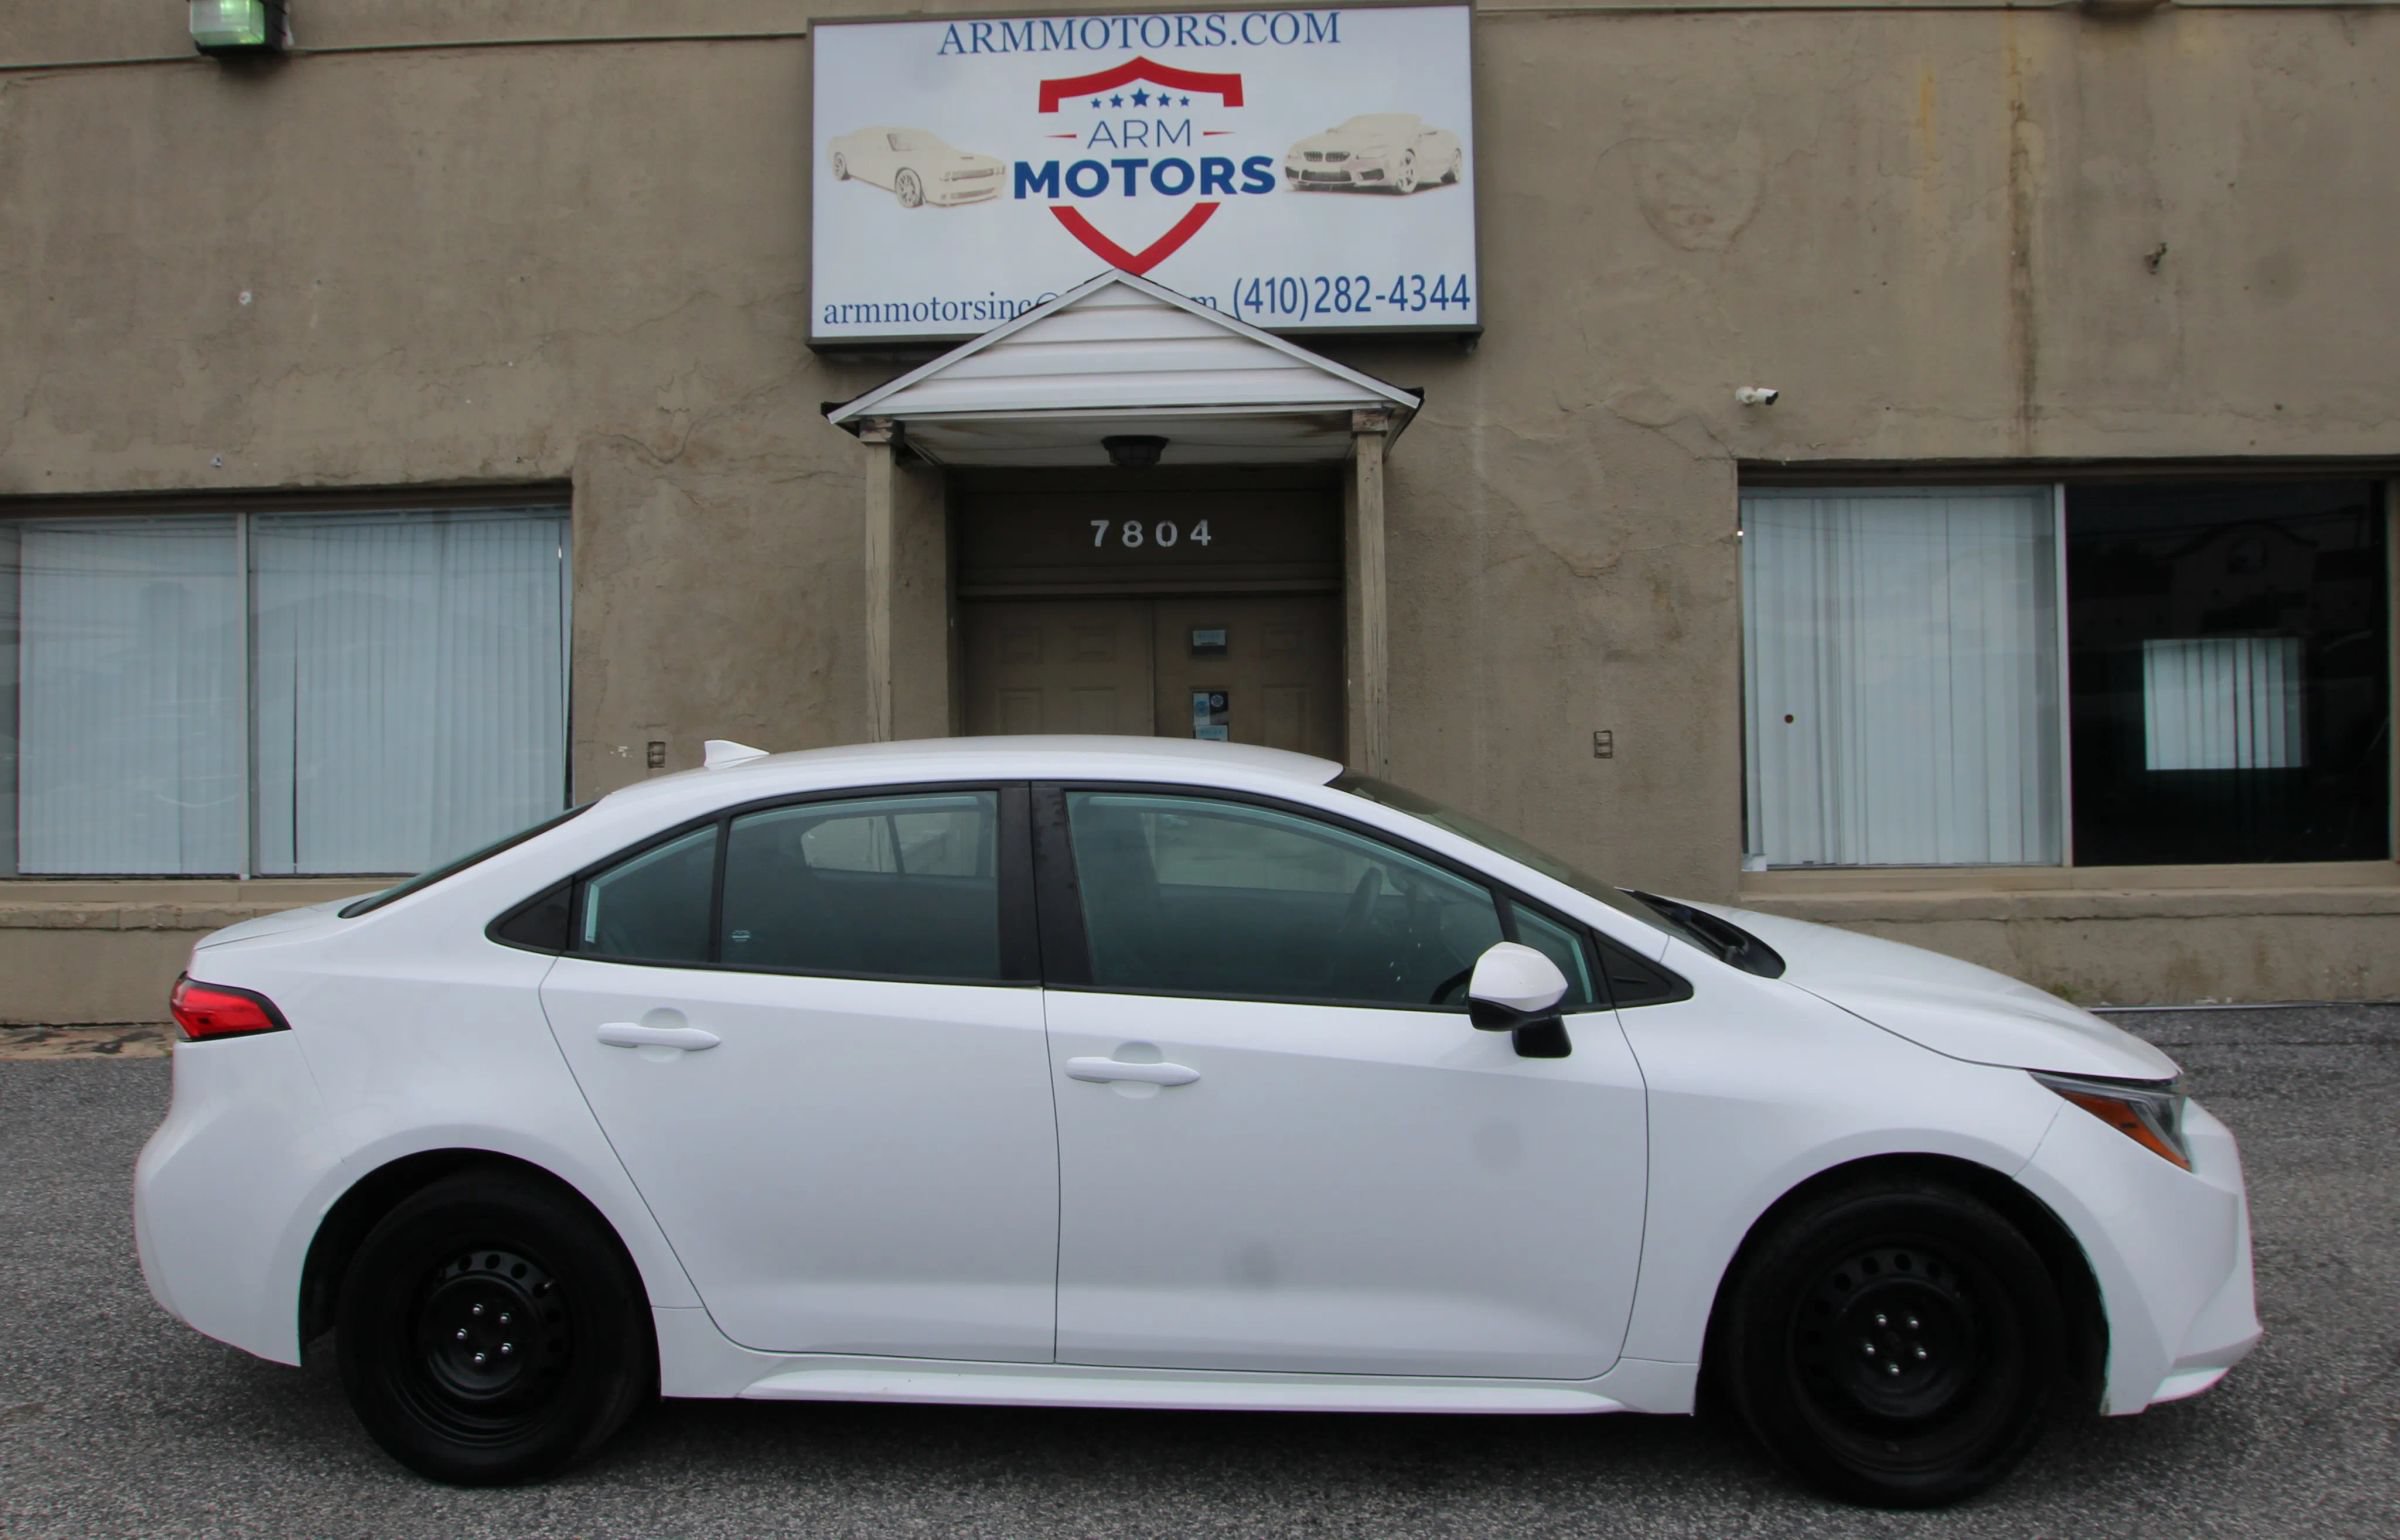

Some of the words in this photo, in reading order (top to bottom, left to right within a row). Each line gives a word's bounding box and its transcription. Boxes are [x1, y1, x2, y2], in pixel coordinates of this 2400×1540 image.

[937, 11, 1342, 56] ARMMOTORS.COM
[1087, 118, 1191, 149] ARM
[1014, 155, 1276, 200] MOTORS
[1090, 519, 1212, 548] 7804
